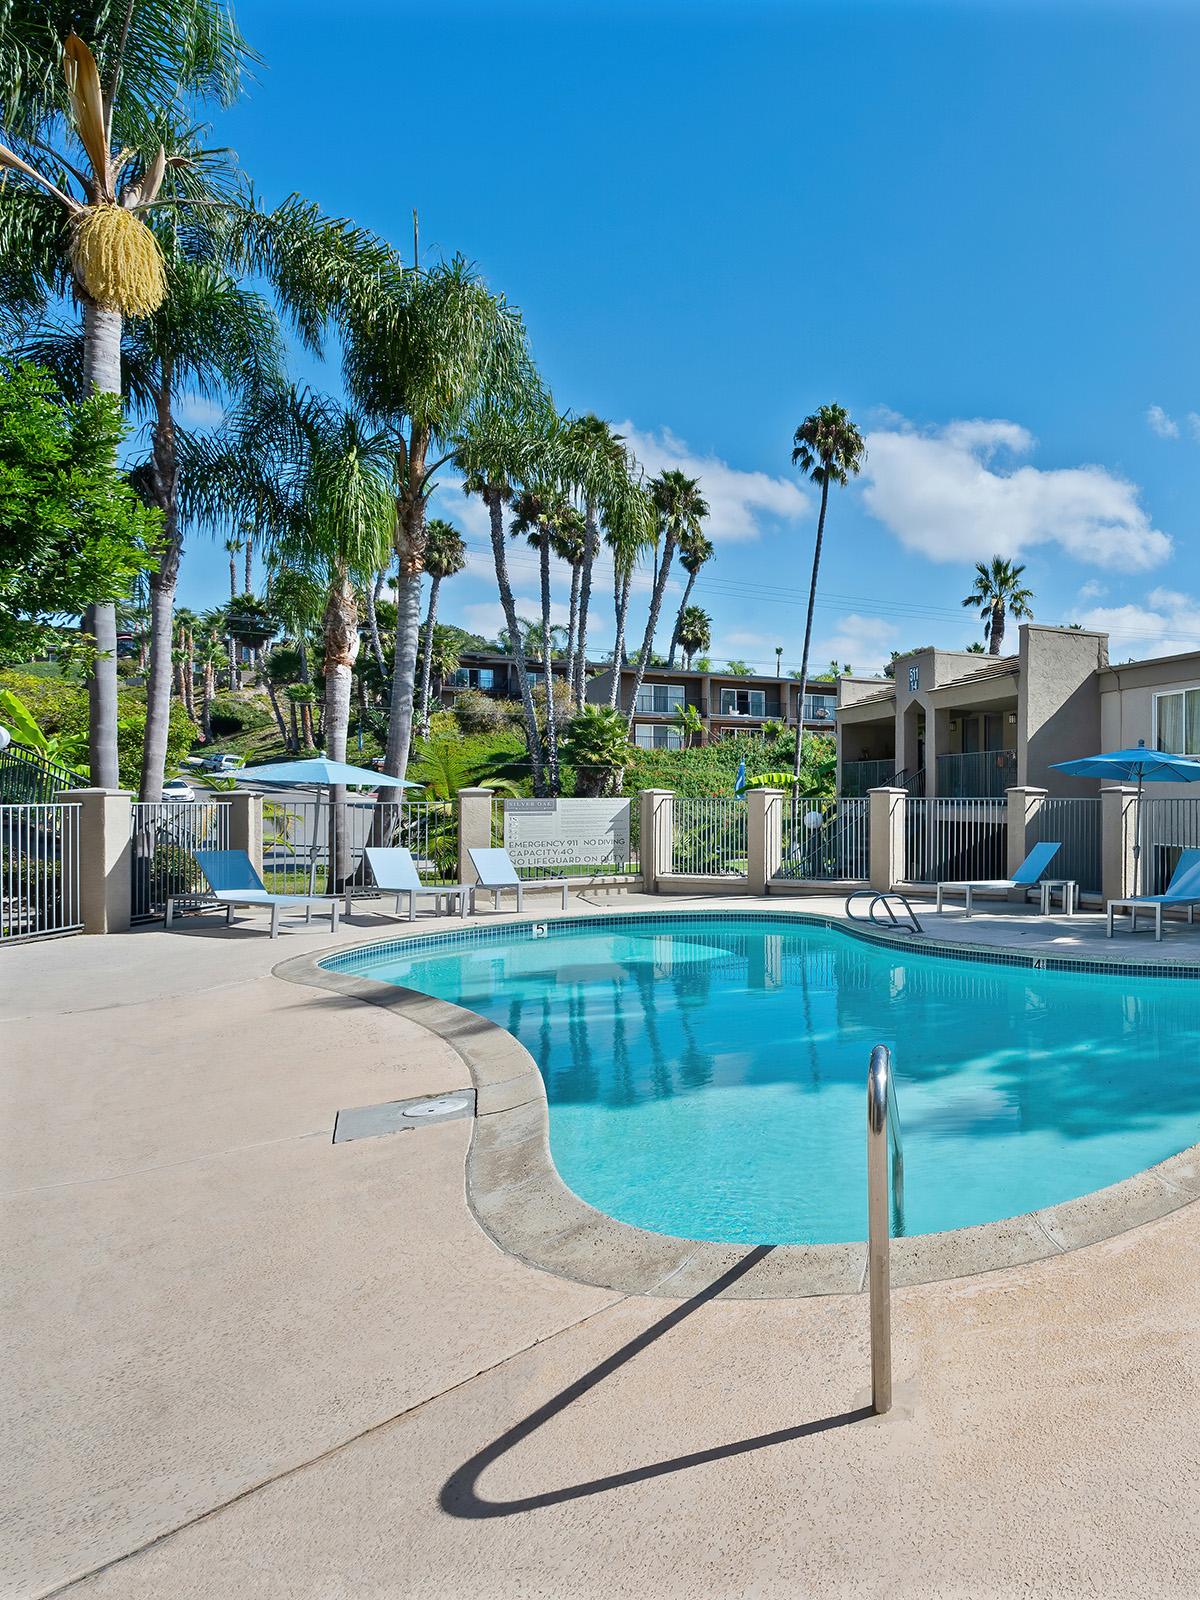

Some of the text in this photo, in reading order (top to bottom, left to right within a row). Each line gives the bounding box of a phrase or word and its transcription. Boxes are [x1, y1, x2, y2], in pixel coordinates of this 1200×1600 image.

[509, 840, 565, 848] EMERGENCY
[598, 838, 625, 846] DIVING
[528, 856, 581, 865] LIFEGUARD
[584, 855, 598, 863] ON
[600, 854, 625, 863] DUTY
[536, 923, 545, 936] 5
